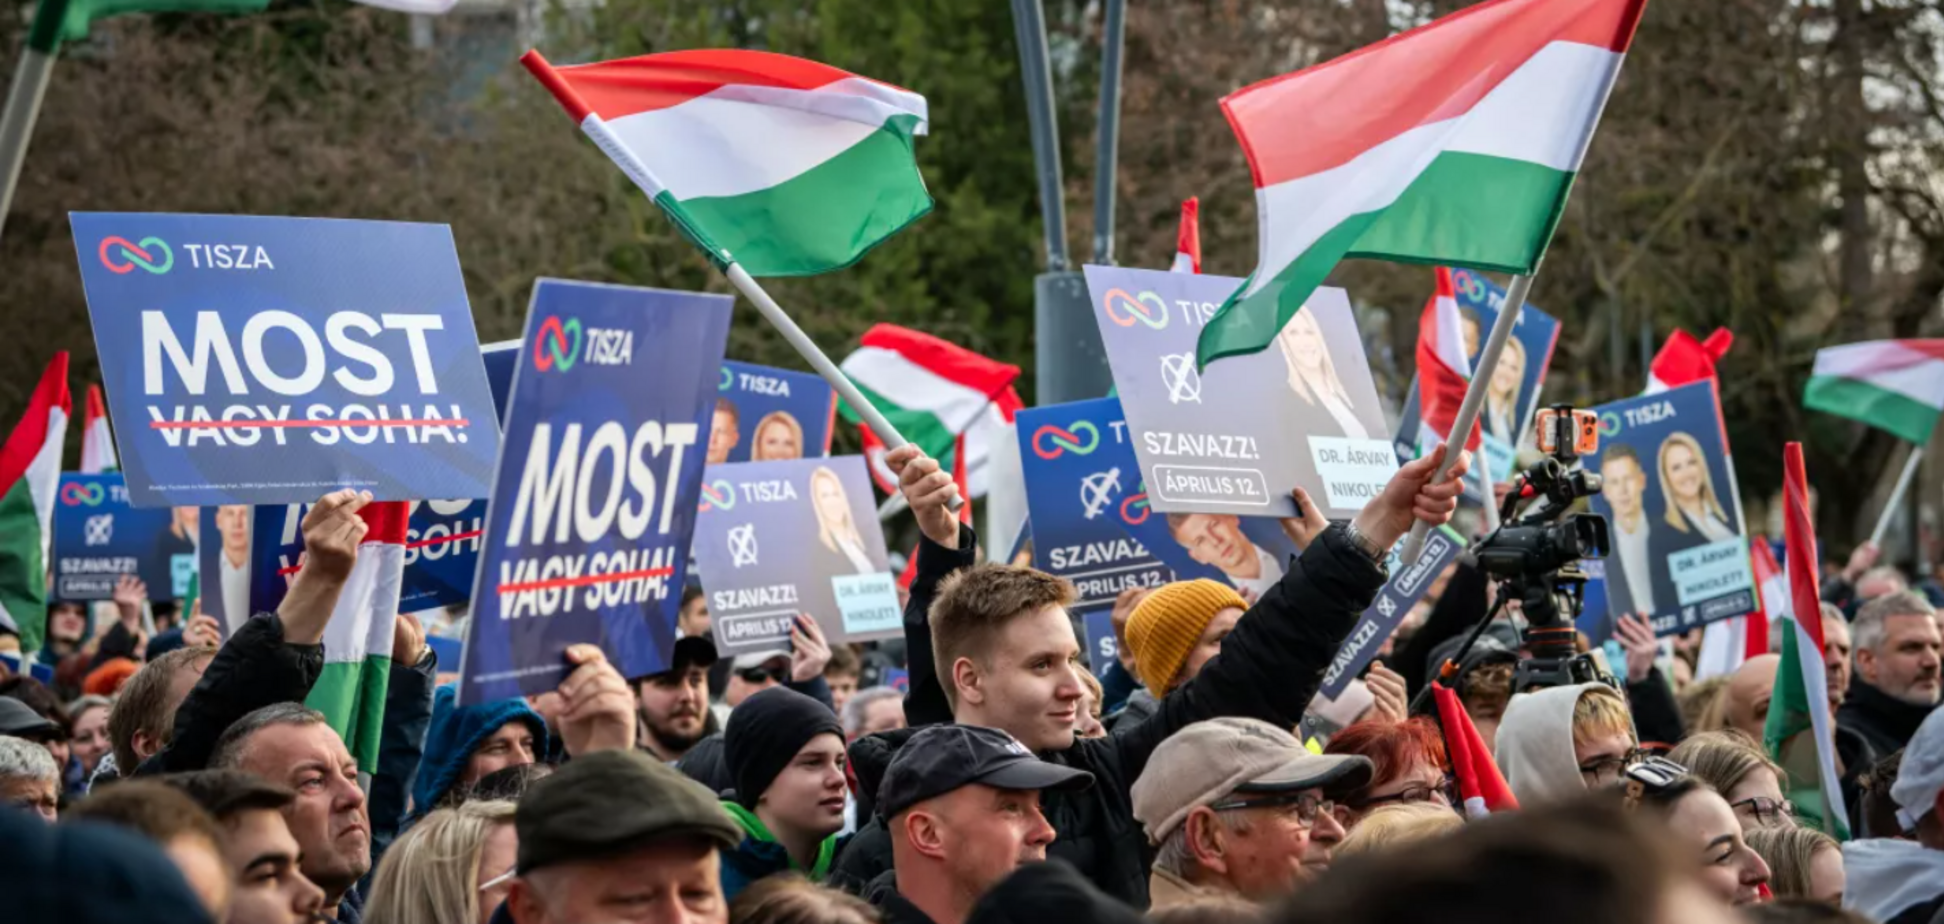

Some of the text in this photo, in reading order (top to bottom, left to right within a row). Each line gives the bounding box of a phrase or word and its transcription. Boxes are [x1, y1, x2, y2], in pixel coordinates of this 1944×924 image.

[183, 244, 275, 270] TISZA
[141, 309, 444, 396] MOST
[584, 328, 633, 364] TISZA
[738, 372, 790, 397] TISZA
[147, 404, 469, 447] VAGY SOHA!
[1624, 401, 1677, 427] TISZA
[1143, 431, 1260, 460] SZAVAZZ!
[1318, 449, 1345, 464] DR.
[1346, 446, 1390, 467] ÁRVAY
[504, 419, 699, 547] MOST
[739, 480, 798, 503] TISZA
[1165, 469, 1260, 496] ÁPRILIS 12.
[1331, 481, 1387, 497] NIKOLE
[1049, 537, 1150, 570] SZAVAZ
[1676, 557, 1697, 572] DR.
[499, 546, 675, 619] VAGY SOHA!
[1074, 570, 1167, 598] PRILIS 12.
[1685, 570, 1744, 595] NIKOLETT
[713, 584, 799, 611] SZAVAZZ!
[728, 619, 779, 639] ÁPRILIS
[1322, 619, 1380, 686] SZAVAZZ!
